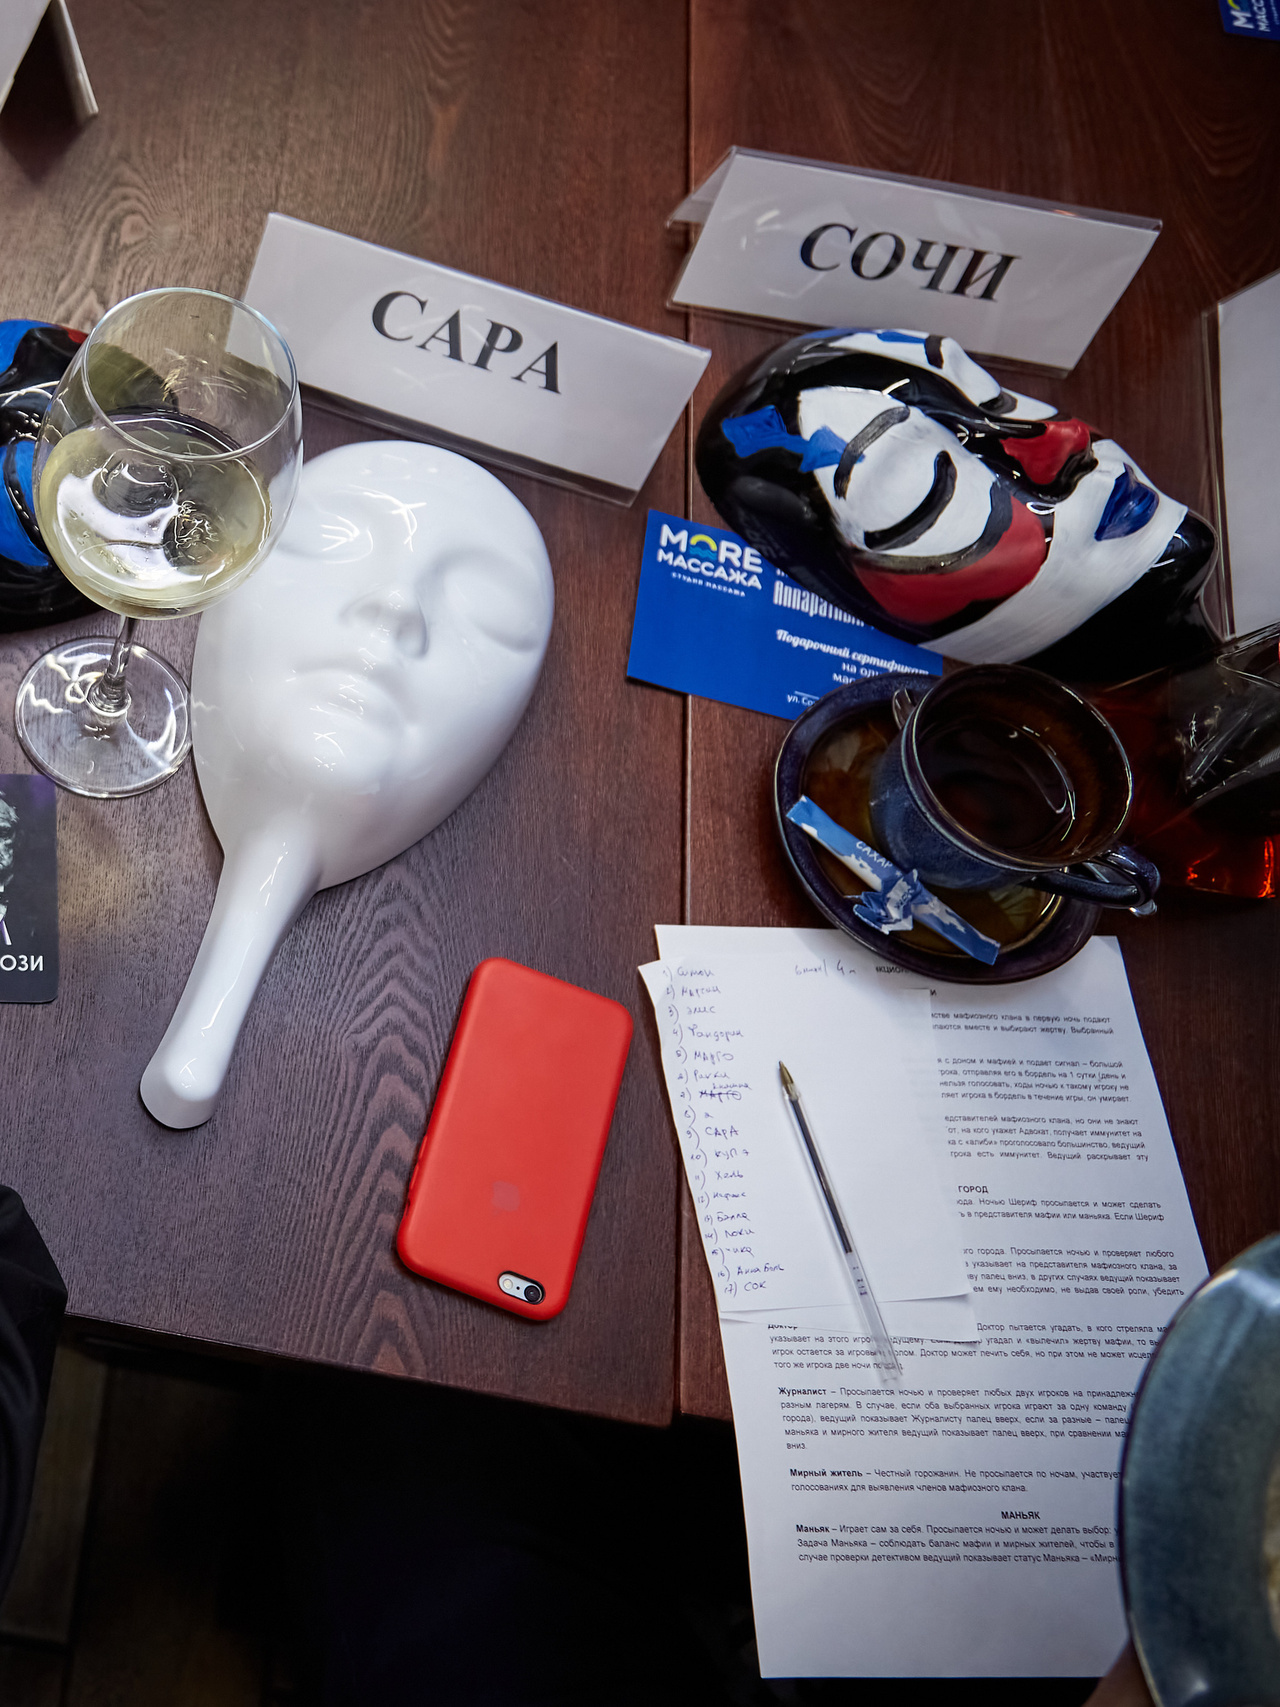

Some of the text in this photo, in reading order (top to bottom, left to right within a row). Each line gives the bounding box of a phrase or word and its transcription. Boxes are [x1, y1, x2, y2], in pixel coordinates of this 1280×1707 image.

[800, 223, 1022, 302] СОЧИ
[372, 291, 562, 394] САРА
[657, 548, 762, 590] МАССАЖА
[776, 629, 850, 659] Подарочный
[958, 1185, 989, 1194] ГОРОД
[977, 1322, 1005, 1332] Доктор
[1116, 1326, 1153, 1334] стреляла
[770, 1335, 811, 1344] указывает
[986, 1337, 1013, 1346] угадал
[1072, 1338, 1101, 1347] жертву
[772, 1349, 794, 1357] игрок
[920, 1348, 948, 1357] Доктор
[778, 1387, 826, 1397] Журналист
[840, 1387, 895, 1397] Просыпается
[937, 1389, 979, 1398] проверяет
[984, 1388, 1012, 1397] любых
[1038, 1390, 1070, 1398] игроков
[780, 1402, 812, 1410] разным
[943, 1401, 991, 1410] выбранных
[994, 1403, 1021, 1411] игрока
[1024, 1403, 1053, 1411] играют
[1093, 1404, 1126, 1412] команду
[820, 1414, 856, 1424] ведущий
[911, 1414, 962, 1425] Журналисту
[966, 1416, 992, 1424] палец
[1061, 1416, 1092, 1425] разные
[830, 1429, 865, 1437] мирного
[901, 1428, 938, 1438] ведущий
[941, 1429, 989, 1437] показывает
[992, 1430, 1018, 1438] палец
[1068, 1430, 1112, 1438] сравнении
[790, 1468, 827, 1479] Мирный
[874, 1469, 911, 1477] Честный
[979, 1471, 1033, 1479] просыпается
[868, 1484, 915, 1492] выявления
[949, 1484, 1000, 1492] мафиозного
[1001, 1511, 1040, 1520] МАНЬЯК
[796, 1524, 830, 1533] Маньяк
[839, 1525, 868, 1534] Играет
[926, 1524, 983, 1535] Просыпается
[985, 1526, 1012, 1534] ночью
[1050, 1527, 1081, 1535] делать
[797, 1538, 828, 1548] Задача
[831, 1539, 868, 1547] Маньяка
[879, 1539, 926, 1548] соблюдать
[928, 1539, 960, 1548] баланс
[962, 1539, 992, 1549] мафии
[1003, 1541, 1036, 1549] мирных
[1080, 1540, 1106, 1548] чтобы
[798, 1554, 828, 1563] случае
[830, 1554, 870, 1563] проверки
[871, 1554, 921, 1562] детективом
[923, 1553, 961, 1563] ведущий
[1013, 1555, 1042, 1563] статус
[1042, 1553, 1080, 1562] Маньяка
